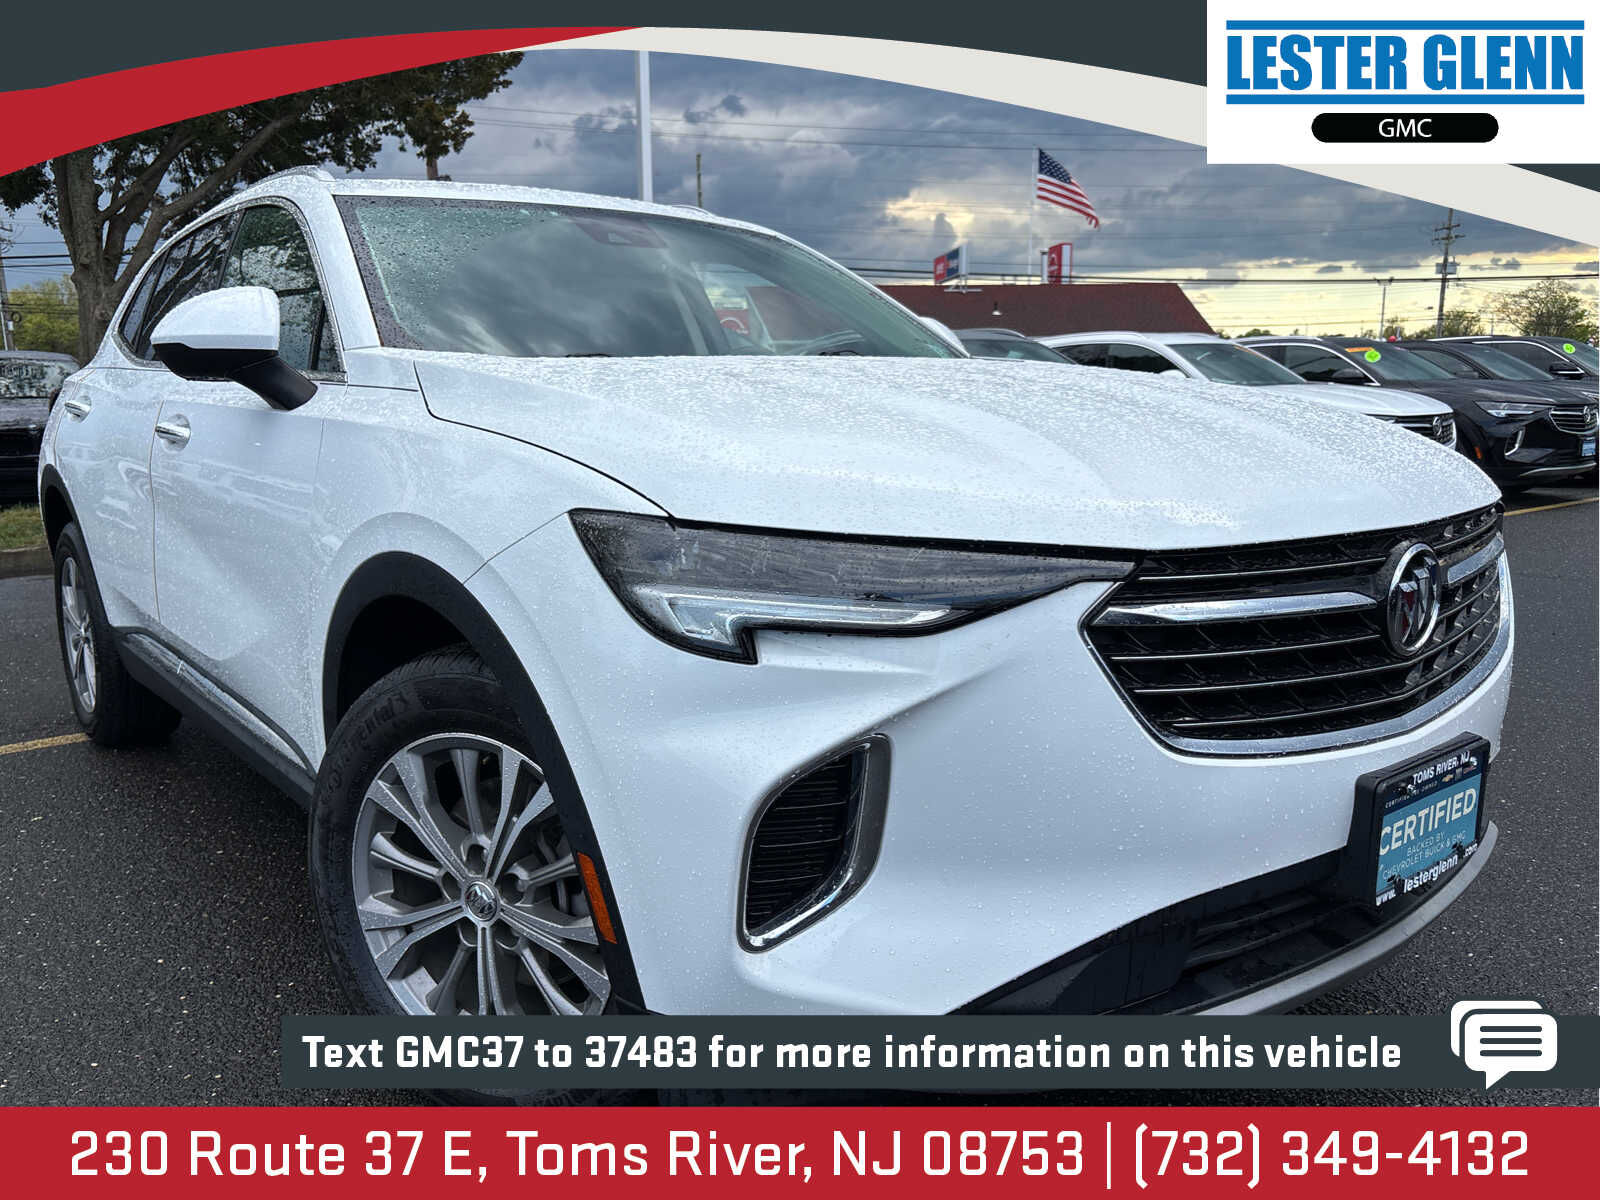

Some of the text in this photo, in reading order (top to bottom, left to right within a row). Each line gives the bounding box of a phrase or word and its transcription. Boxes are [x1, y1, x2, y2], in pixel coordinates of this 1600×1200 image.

[1412, 766, 1435, 785] TOMS
[1460, 750, 1470, 765] NJ
[1379, 788, 1477, 856] CERTIFIED
[1407, 831, 1446, 857] BACKED BY
[1382, 853, 1421, 880] CHEVROLET
[1424, 842, 1445, 858] BUICK
[1452, 830, 1467, 846] GMC
[1403, 854, 1459, 894] lesterglenn
[1463, 843, 1479, 858] .com
